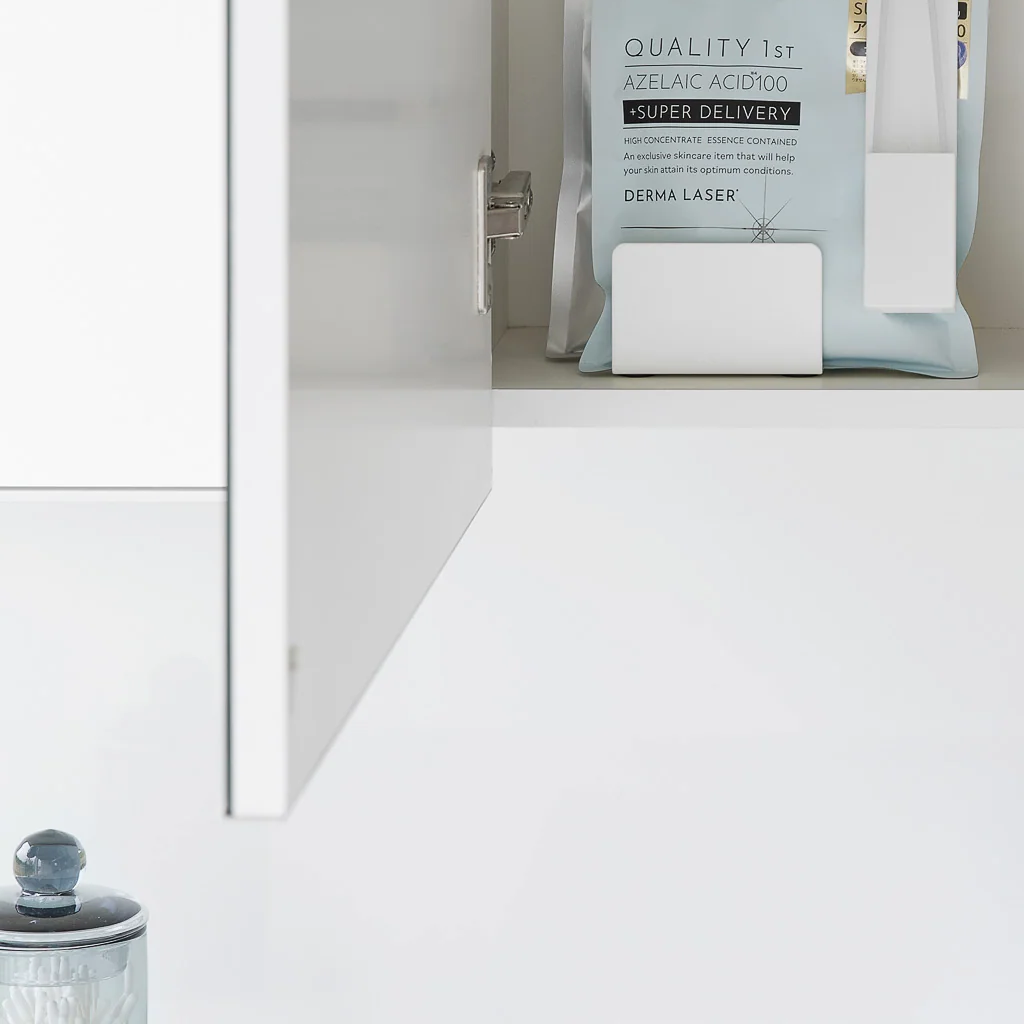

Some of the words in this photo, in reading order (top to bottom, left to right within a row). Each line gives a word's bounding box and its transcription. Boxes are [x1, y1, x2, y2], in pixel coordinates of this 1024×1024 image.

[625, 37, 750, 57] QUALITY
[763, 40, 794, 58] 1ST
[623, 74, 702, 90] AZELAIC
[630, 105, 692, 119] +SUPER
[700, 105, 792, 121] DELIVERY
[644, 136, 702, 144] CONCENTRATE
[746, 137, 798, 146] CONTAINED
[624, 152, 635, 160] An
[636, 152, 672, 160] exclusive
[673, 151, 712, 160] skincare
[714, 152, 734, 160] item
[736, 152, 756, 161] that
[758, 153, 773, 162] will
[775, 153, 796, 162] help
[624, 167, 642, 176] your
[643, 166, 659, 174] skin
[660, 166, 684, 174] attain
[686, 166, 698, 174] its
[700, 166, 741, 175] optimum
[743, 166, 794, 175] conditions.
[624, 189, 676, 202] DERMA
